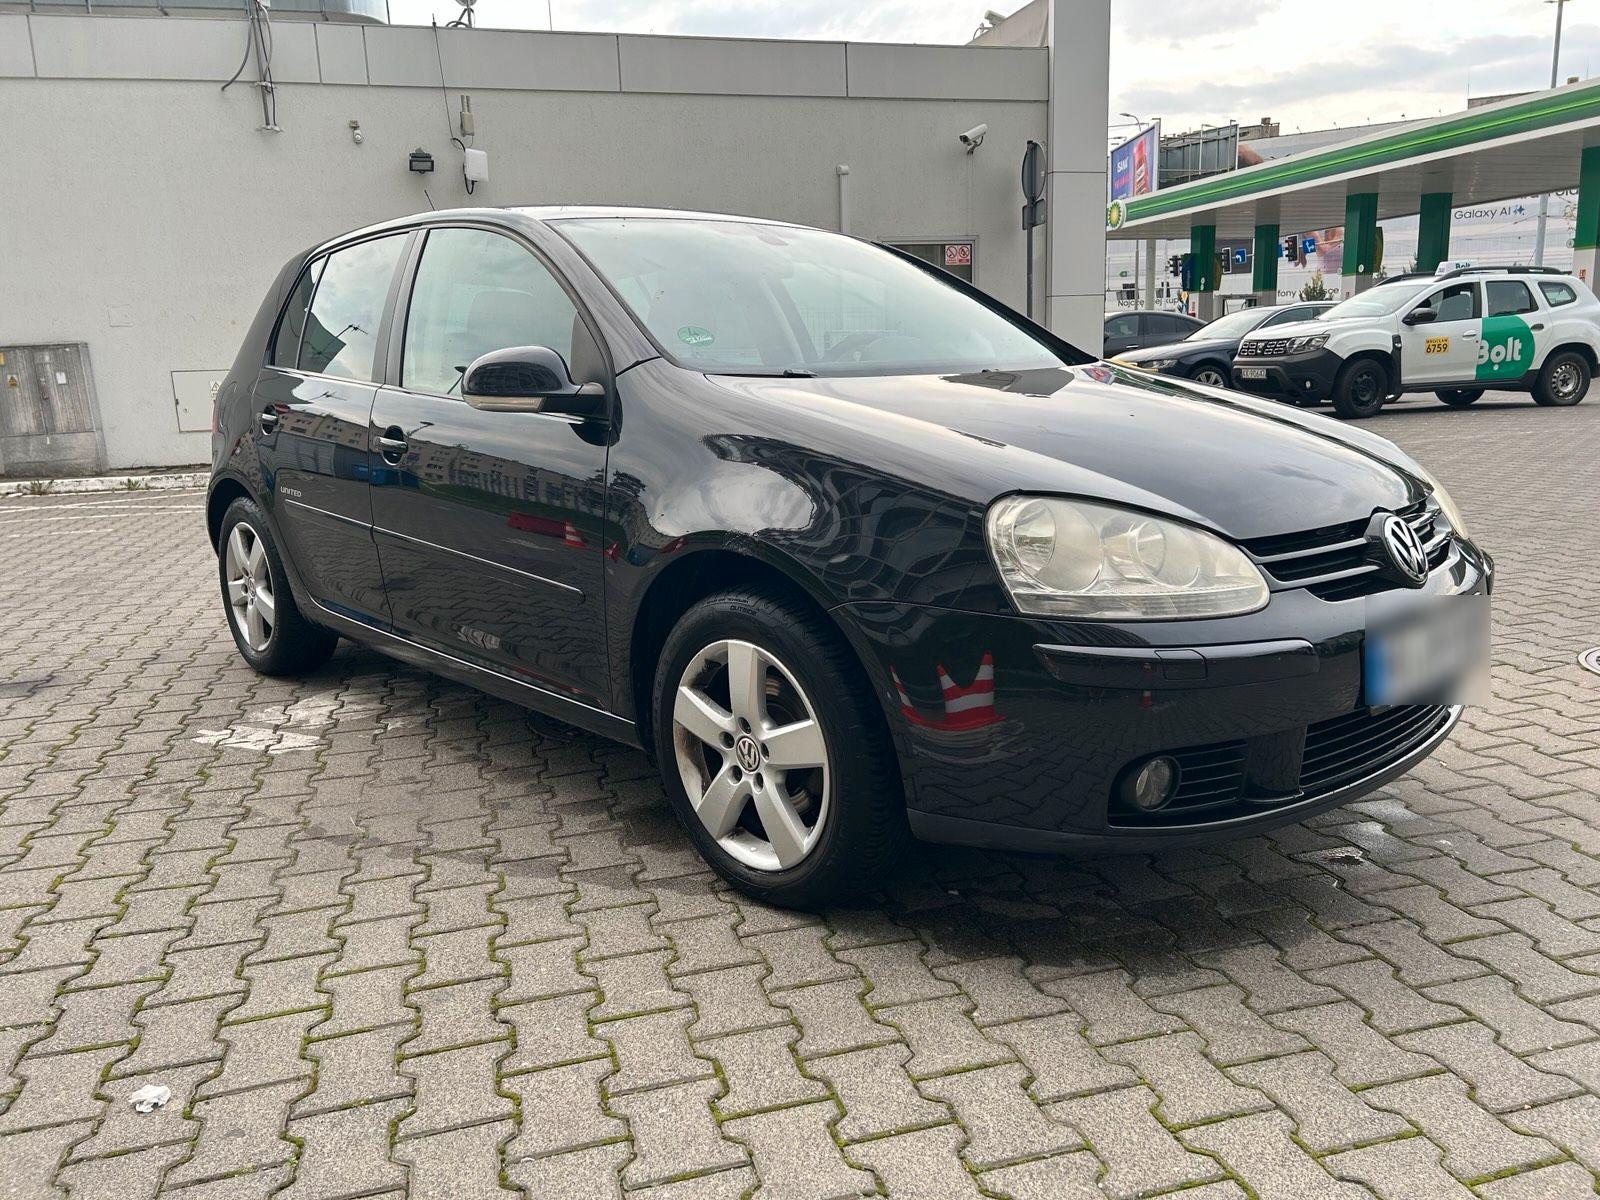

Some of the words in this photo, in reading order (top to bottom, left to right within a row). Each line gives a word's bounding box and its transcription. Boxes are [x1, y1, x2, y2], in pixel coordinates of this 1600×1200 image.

[1454, 207, 1498, 220] Galaxy
[1499, 207, 1511, 216] AI
[1277, 288, 1297, 299] fony
[1426, 343, 1448, 353] 6759
[1474, 337, 1522, 370] Bolt
[280, 486, 302, 498] UNITED
[737, 737, 759, 771] VW
